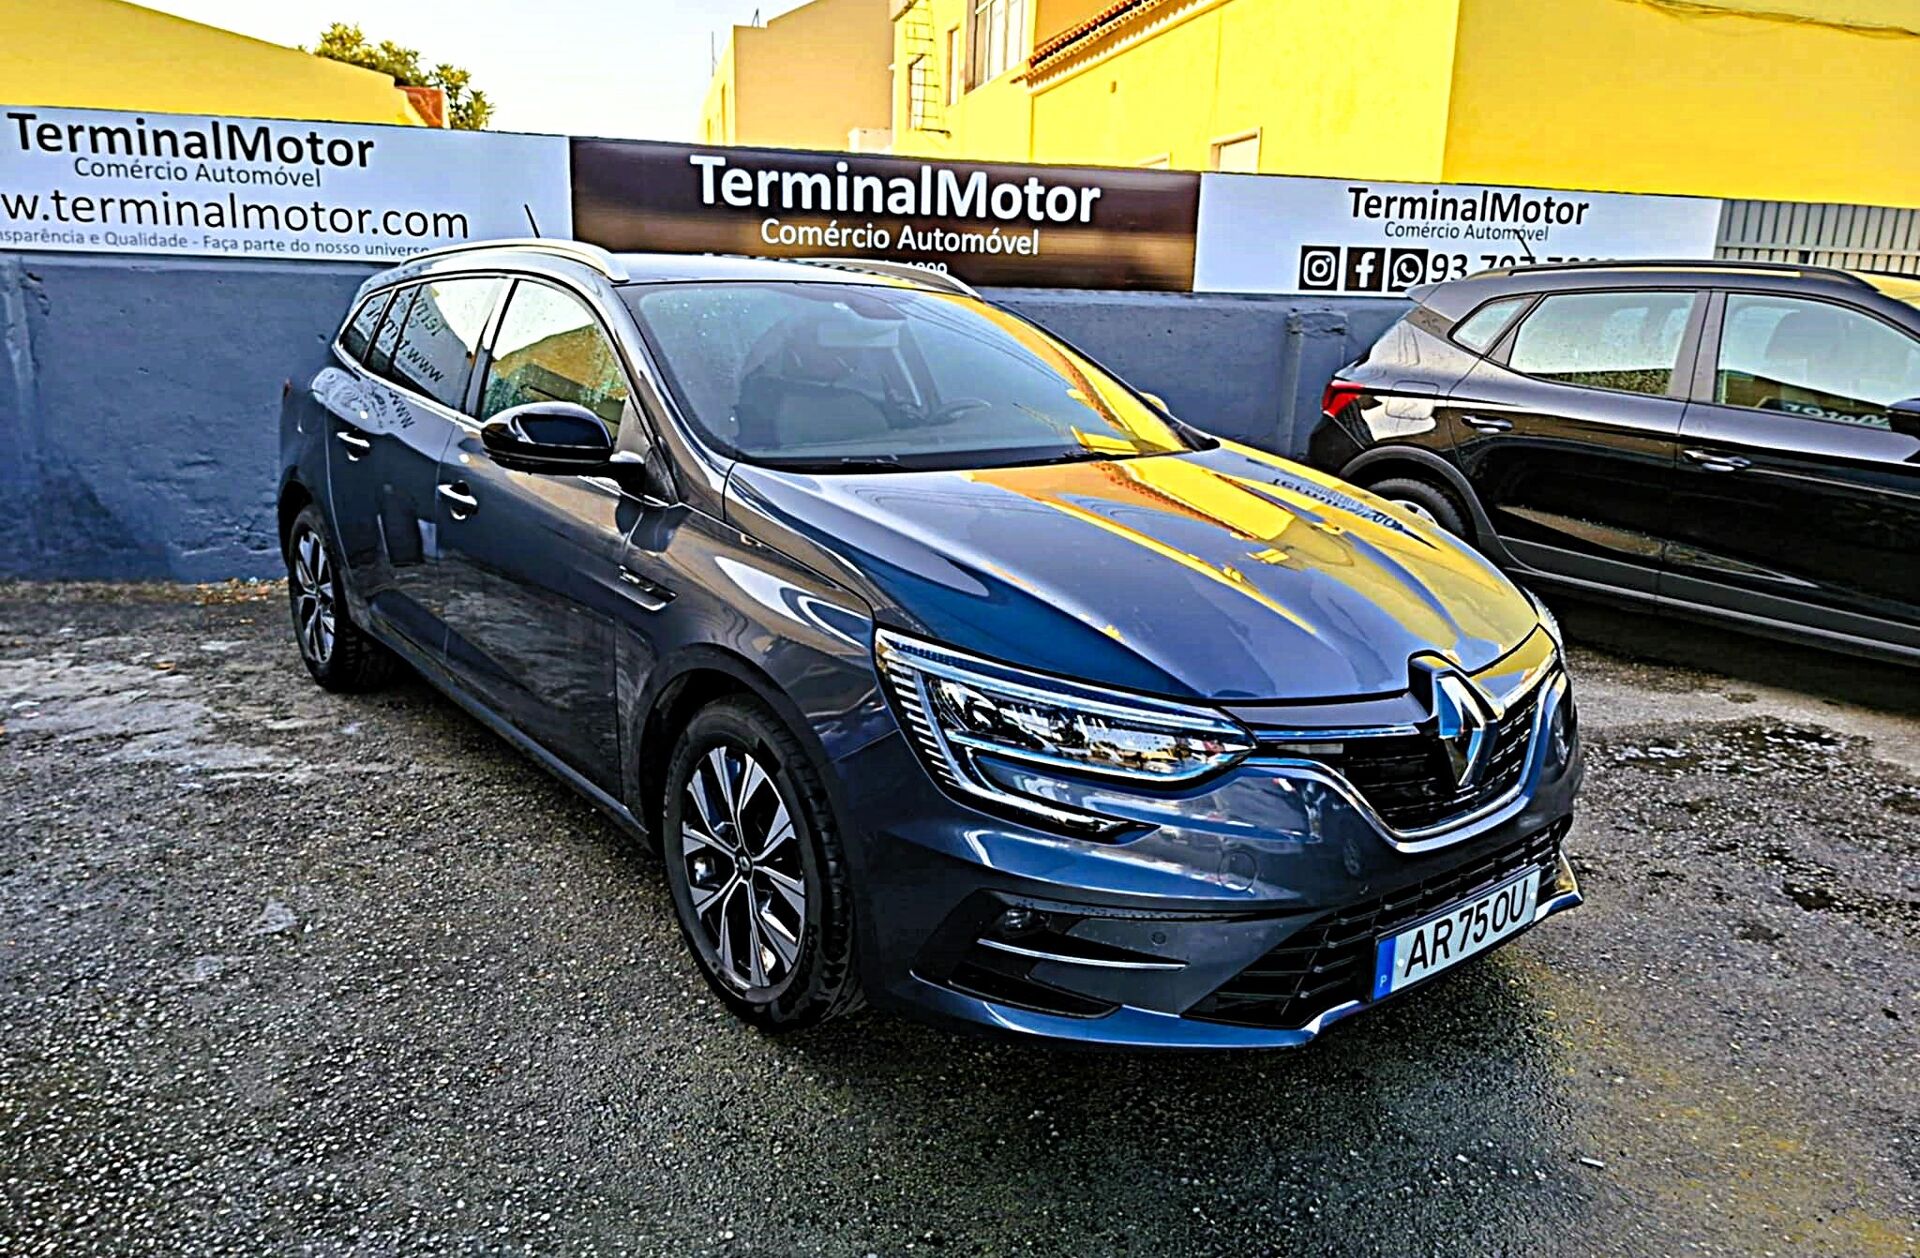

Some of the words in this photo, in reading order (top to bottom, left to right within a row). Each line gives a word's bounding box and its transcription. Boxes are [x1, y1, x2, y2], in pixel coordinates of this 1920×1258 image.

[8, 113, 374, 167] TerminalMotor
[74, 157, 188, 182] Comércio
[195, 166, 321, 188] Automóvel
[690, 155, 1100, 222] TerminalMotor
[1, 190, 468, 238] w.terminalmotor.com
[1349, 188, 1589, 225] TerminalMotor
[90, 234, 100, 245] e
[104, 231, 188, 248] Qualidade
[203, 235, 238, 252] Faça
[243, 237, 286, 254] parte
[290, 238, 311, 252] do
[315, 241, 360, 255] nosso
[762, 218, 889, 248] Comércio
[898, 226, 1039, 255] Automóvel
[1385, 221, 1460, 238] Comércio
[1464, 224, 1549, 241] Automóvel
